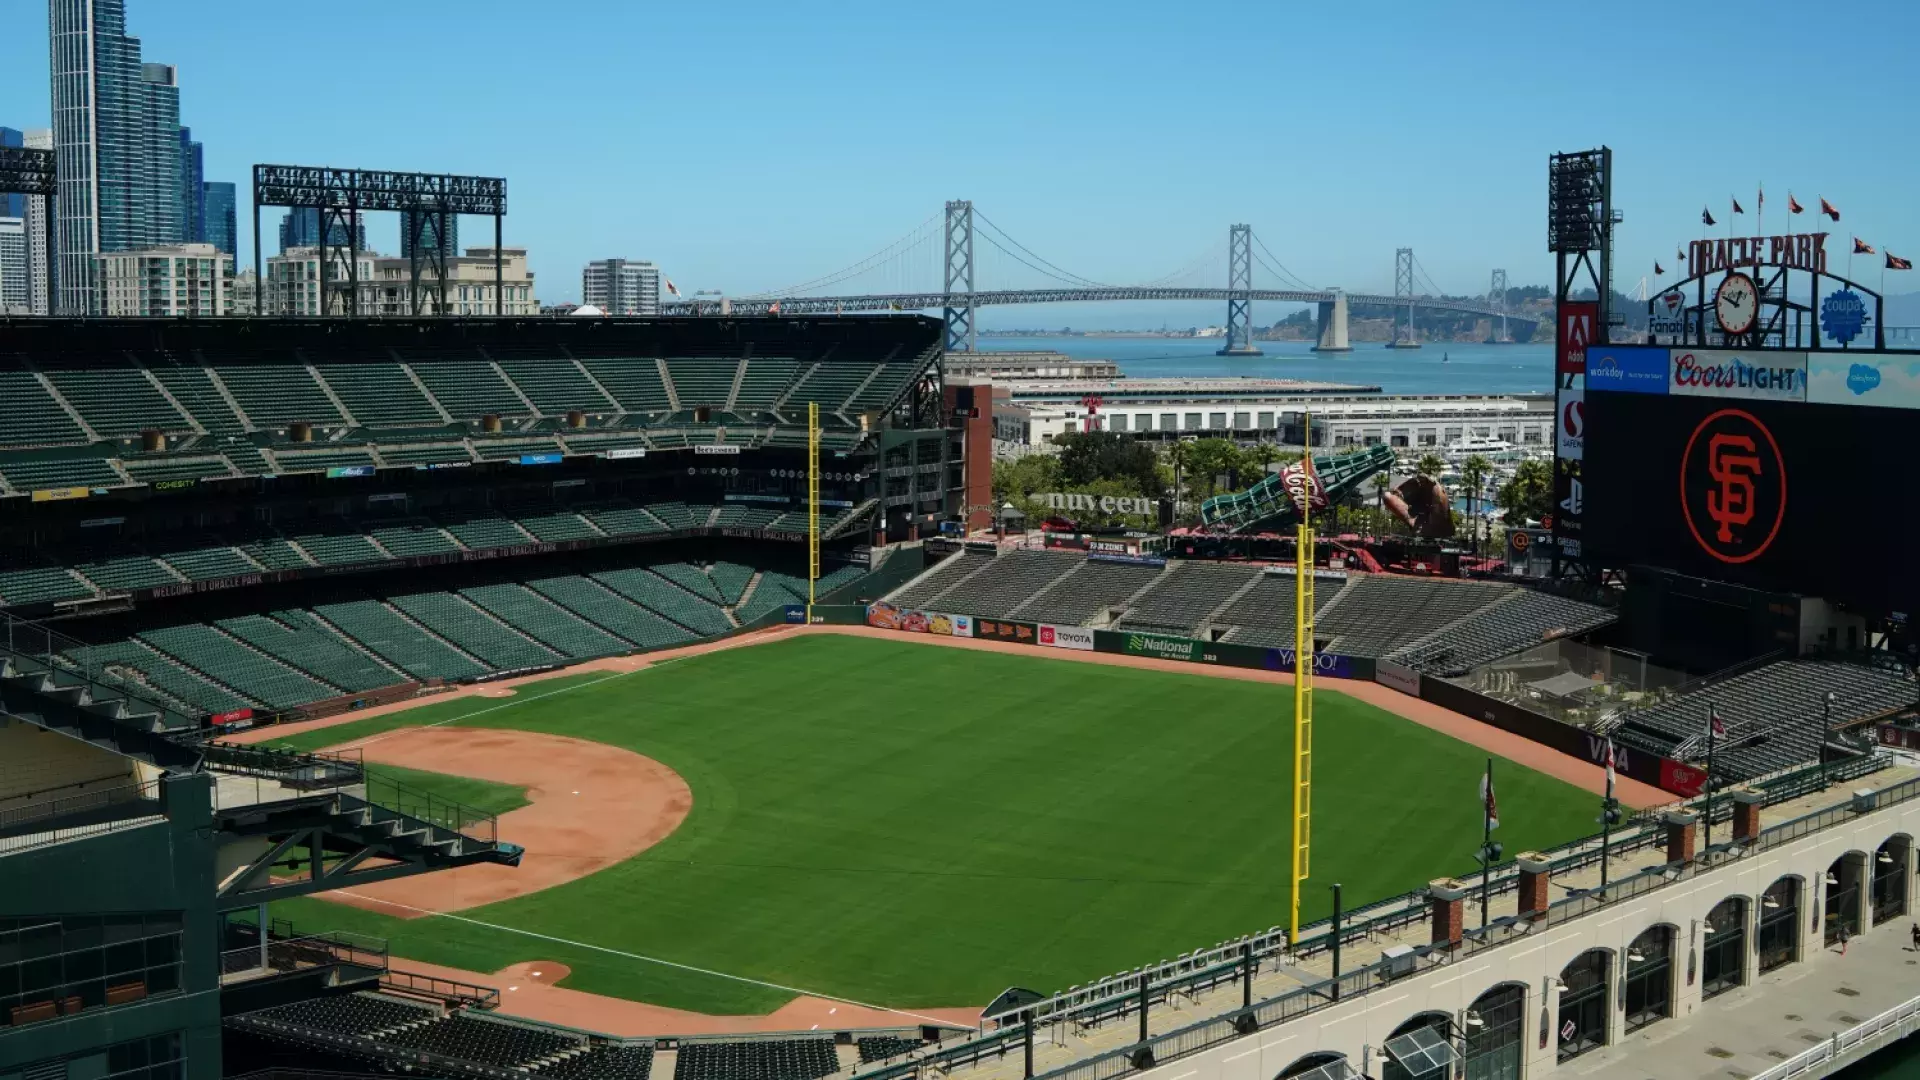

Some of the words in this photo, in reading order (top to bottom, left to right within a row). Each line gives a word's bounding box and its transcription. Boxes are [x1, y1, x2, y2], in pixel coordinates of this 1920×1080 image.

[1689, 238, 1764, 278] ORACLE
[1770, 233, 1829, 275] PARK
[1826, 299, 1861, 314] coupa
[1649, 317, 1695, 333] Fanatis
[1590, 366, 1623, 380] workday
[1674, 354, 1736, 388] Coors
[1738, 366, 1796, 390] LIGHT
[155, 479, 196, 490] COHESITY
[1707, 433, 1761, 543] SF
[1047, 493, 1151, 515] nuveen
[463, 549, 498, 562] WELCOME
[499, 548, 509, 558] TO
[510, 545, 537, 557] ORACLE
[538, 542, 557, 553] PARK
[152, 584, 195, 599] WELCOME
[196, 582, 207, 593] TO
[208, 577, 241, 591] ORACLE
[242, 574, 264, 586] PARK
[1057, 632, 1091, 645] TOYOTA
[1143, 637, 1193, 653] National
[1160, 651, 1171, 659] Car
[1279, 649, 1338, 670] YAOO!
[1587, 736, 1628, 771] VIA
